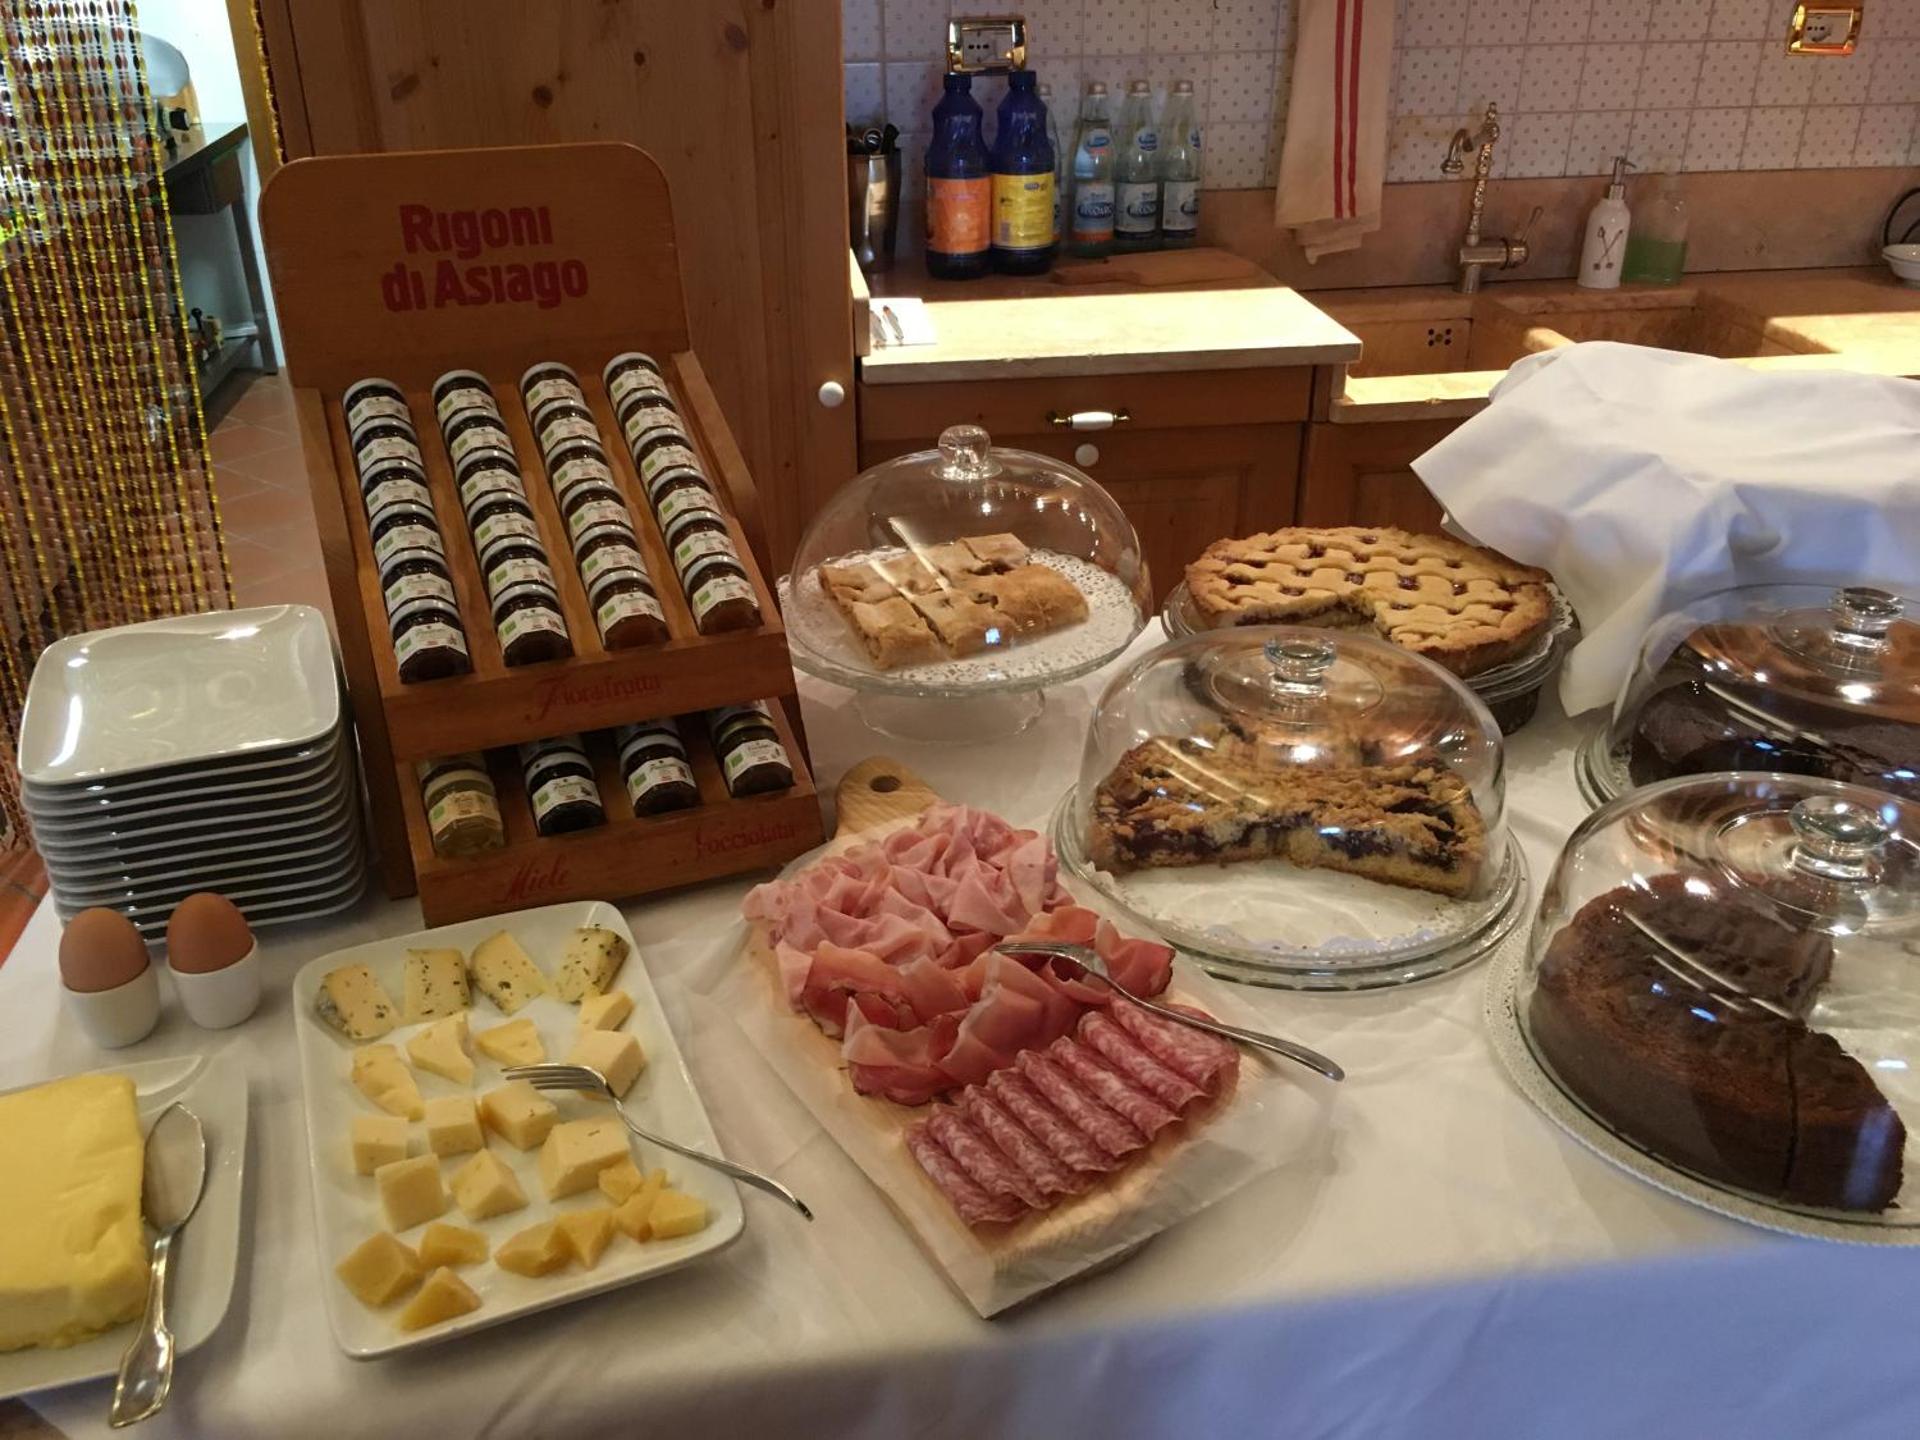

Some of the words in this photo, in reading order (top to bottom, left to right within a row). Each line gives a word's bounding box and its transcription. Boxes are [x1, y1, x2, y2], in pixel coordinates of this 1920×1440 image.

[400, 204, 553, 260] Rigoni
[381, 262, 427, 312] di
[434, 259, 589, 310] Asiago
[501, 855, 571, 902] Miele
